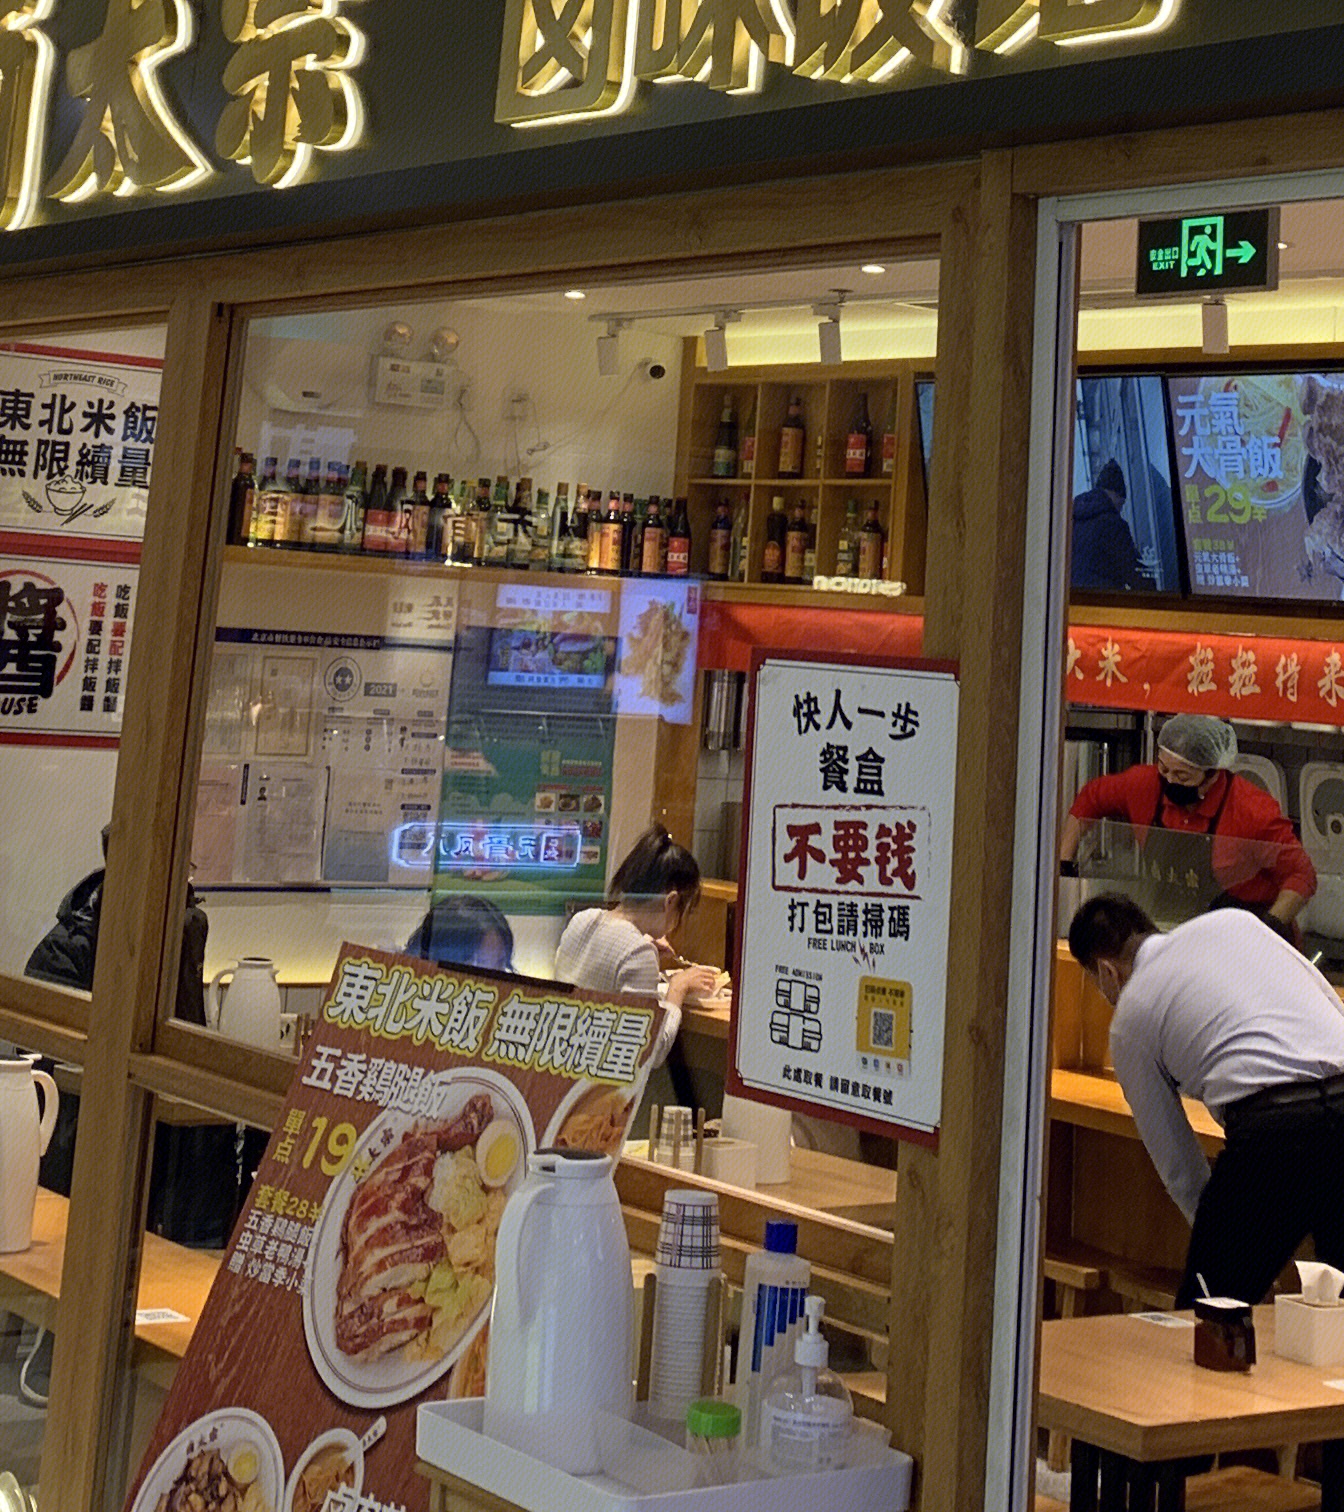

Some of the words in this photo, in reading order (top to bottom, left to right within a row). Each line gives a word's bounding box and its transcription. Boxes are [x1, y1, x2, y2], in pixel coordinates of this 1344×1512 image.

[1152, 260, 1176, 271] EXIT
[52, 372, 96, 384] NORTHEAST
[97, 377, 115, 388] RICE
[1175, 390, 1245, 438] 元氣
[1183, 435, 1284, 481] 大骨飯
[368, 684, 396, 696] 2021
[792, 687, 920, 742] 快人一步
[818, 741, 886, 797] 餐盒
[782, 818, 918, 891] 不要钱
[787, 897, 911, 942] 打包請掃碼
[807, 937, 828, 951] FREE
[830, 939, 857, 954] LUNCH
[869, 942, 885, 956] BOX
[774, 964, 789, 976] FREE
[326, 961, 496, 1054] 東北米飯
[484, 993, 652, 1083] 無限續量
